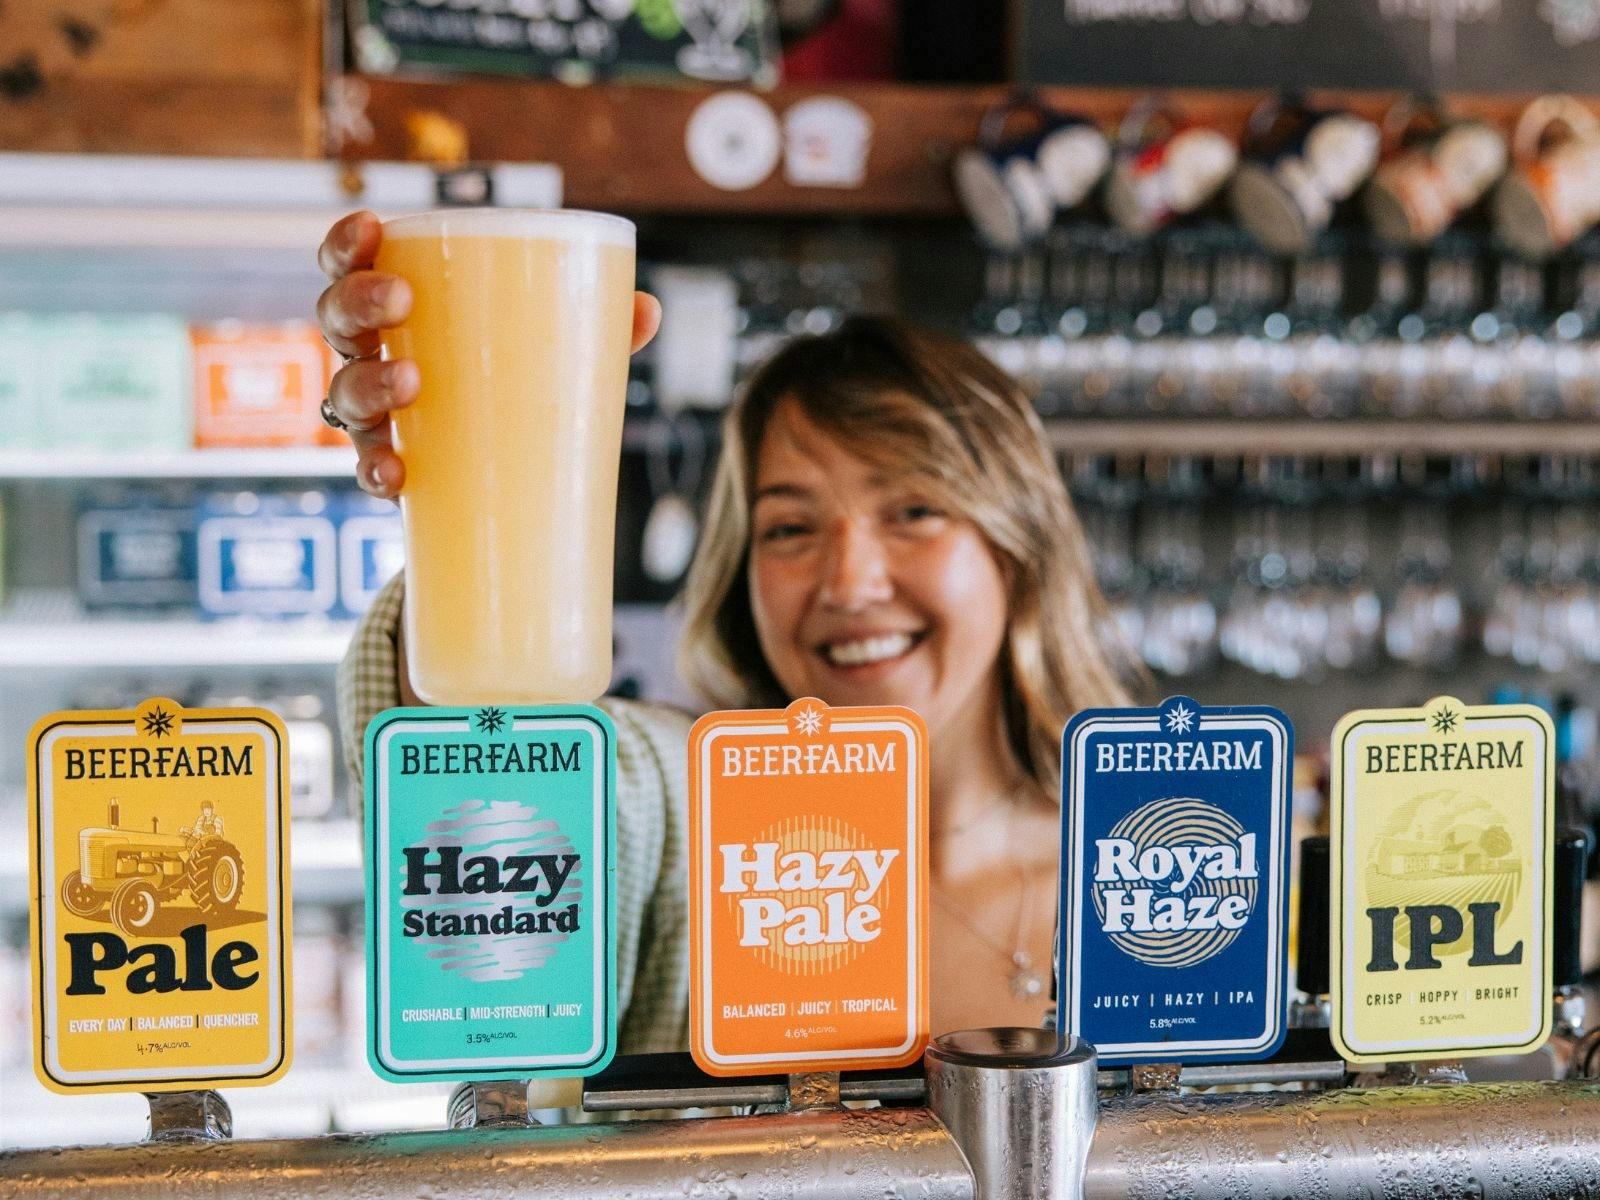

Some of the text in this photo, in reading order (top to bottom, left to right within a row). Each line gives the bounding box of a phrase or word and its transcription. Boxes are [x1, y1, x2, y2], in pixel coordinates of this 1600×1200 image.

[64, 745, 253, 780] BEERFARM
[401, 741, 582, 775] BEERFARM
[721, 742, 896, 777] BEERFARM
[1095, 740, 1263, 773] BEERFARM
[1365, 740, 1524, 774] BEERFARM
[402, 846, 581, 908] Hazy
[719, 842, 900, 903] Hazy
[1094, 832, 1259, 893] Royal
[403, 904, 580, 938] Standard
[738, 891, 882, 947] Pale
[1101, 888, 1250, 933] Haze
[1365, 902, 1524, 972] IPL
[64, 923, 260, 996] Pale
[402, 1003, 582, 1022] CRUSHABLE MID-STRENGTH JUICY
[722, 998, 897, 1019] BALANCED JUICY TROPICAL
[1093, 991, 1254, 1009] JUICY HAZY IPA
[1366, 987, 1518, 1006] CRISP HOPPY BRIGHT
[69, 1013, 259, 1033] EVERY DAY BALANCED QUENCHER
